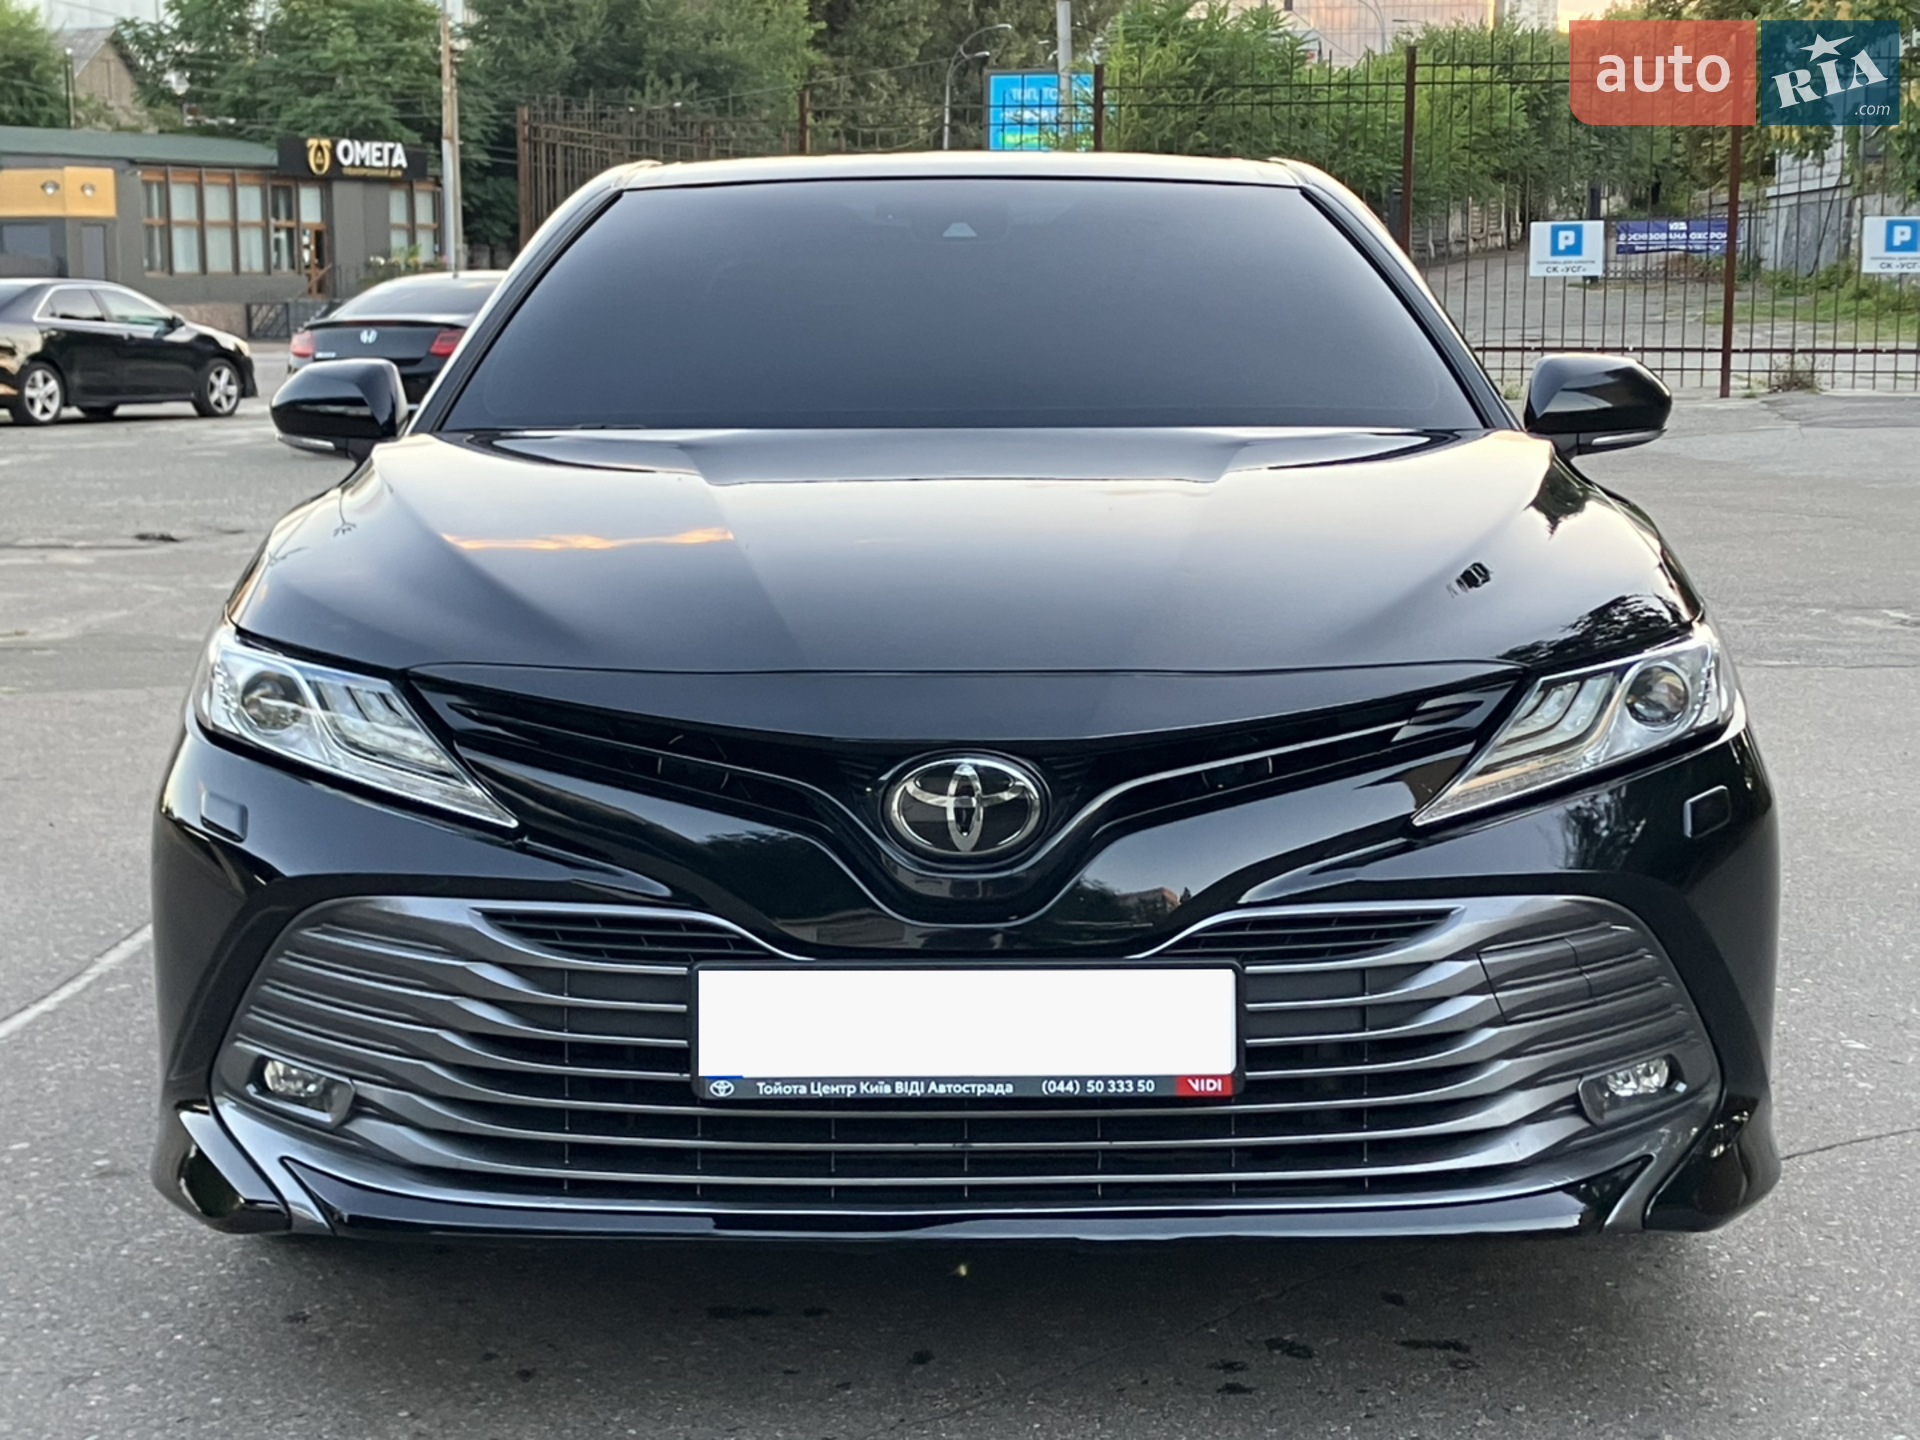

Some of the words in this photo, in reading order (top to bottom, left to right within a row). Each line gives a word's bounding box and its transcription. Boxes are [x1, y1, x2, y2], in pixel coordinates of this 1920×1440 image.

[336, 139, 408, 168] ОМЕГА
[1558, 230, 1576, 251] P
[1893, 225, 1912, 246] P
[756, 1081, 807, 1095] Тойота
[810, 1081, 857, 1097] Центр
[860, 1080, 892, 1094] Київ
[895, 1081, 925, 1096] ВІДІ
[927, 1081, 1014, 1096] Автострада
[1041, 1080, 1081, 1095] (044)
[1086, 1079, 1104, 1093] 50
[1107, 1079, 1134, 1092] 333
[1136, 1079, 1155, 1092] 50
[1188, 1078, 1222, 1092] VIDI
